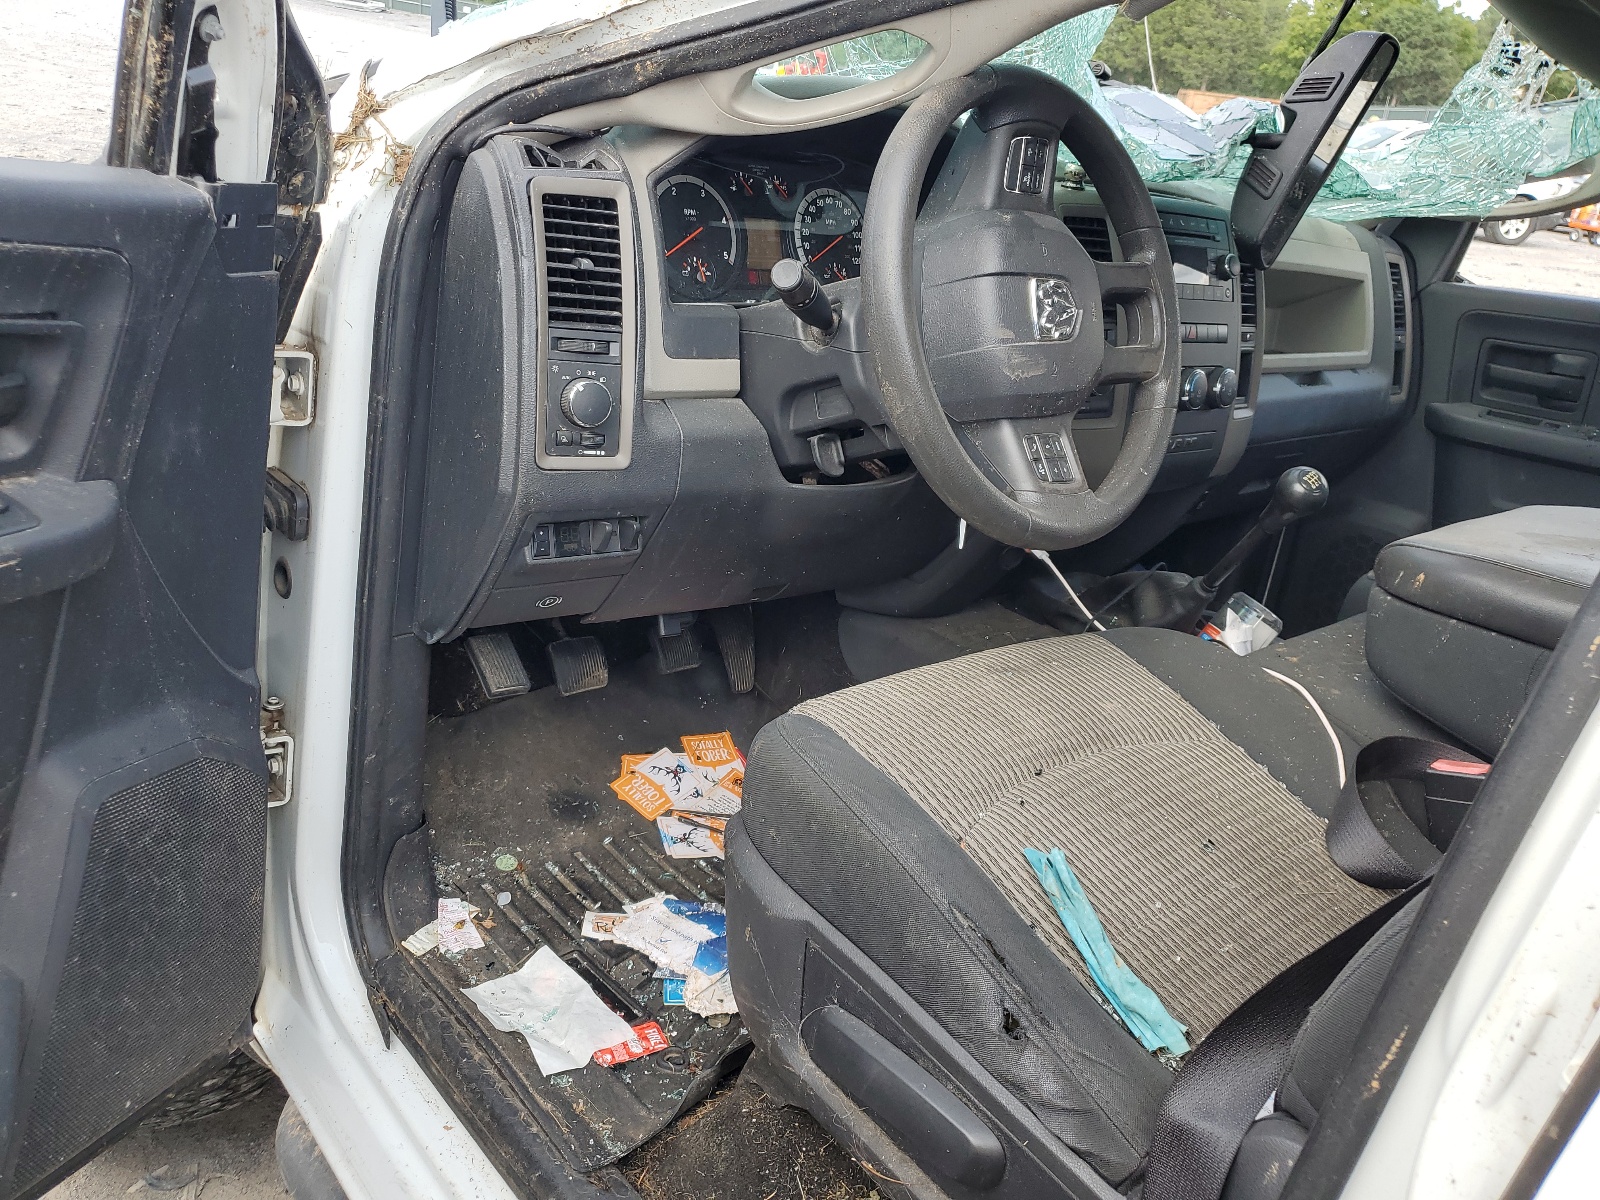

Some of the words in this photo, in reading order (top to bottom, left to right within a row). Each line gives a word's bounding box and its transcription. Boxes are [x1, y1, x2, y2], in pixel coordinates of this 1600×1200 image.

[671, 187, 677, 196] 2
[700, 189, 706, 197] 3
[817, 199, 824, 207] 50
[825, 196, 834, 204] 60
[683, 208, 697, 216] RPM
[808, 205, 816, 213] 40
[843, 208, 852, 216] 80
[721, 216, 727, 225] 4
[850, 219, 859, 227] 90
[803, 241, 810, 250] 10
[723, 251, 729, 260] 5
[691, 739, 724, 750] SOTALLY
[695, 747, 732, 762] TOBER
[622, 784, 656, 812] SOTALLY
